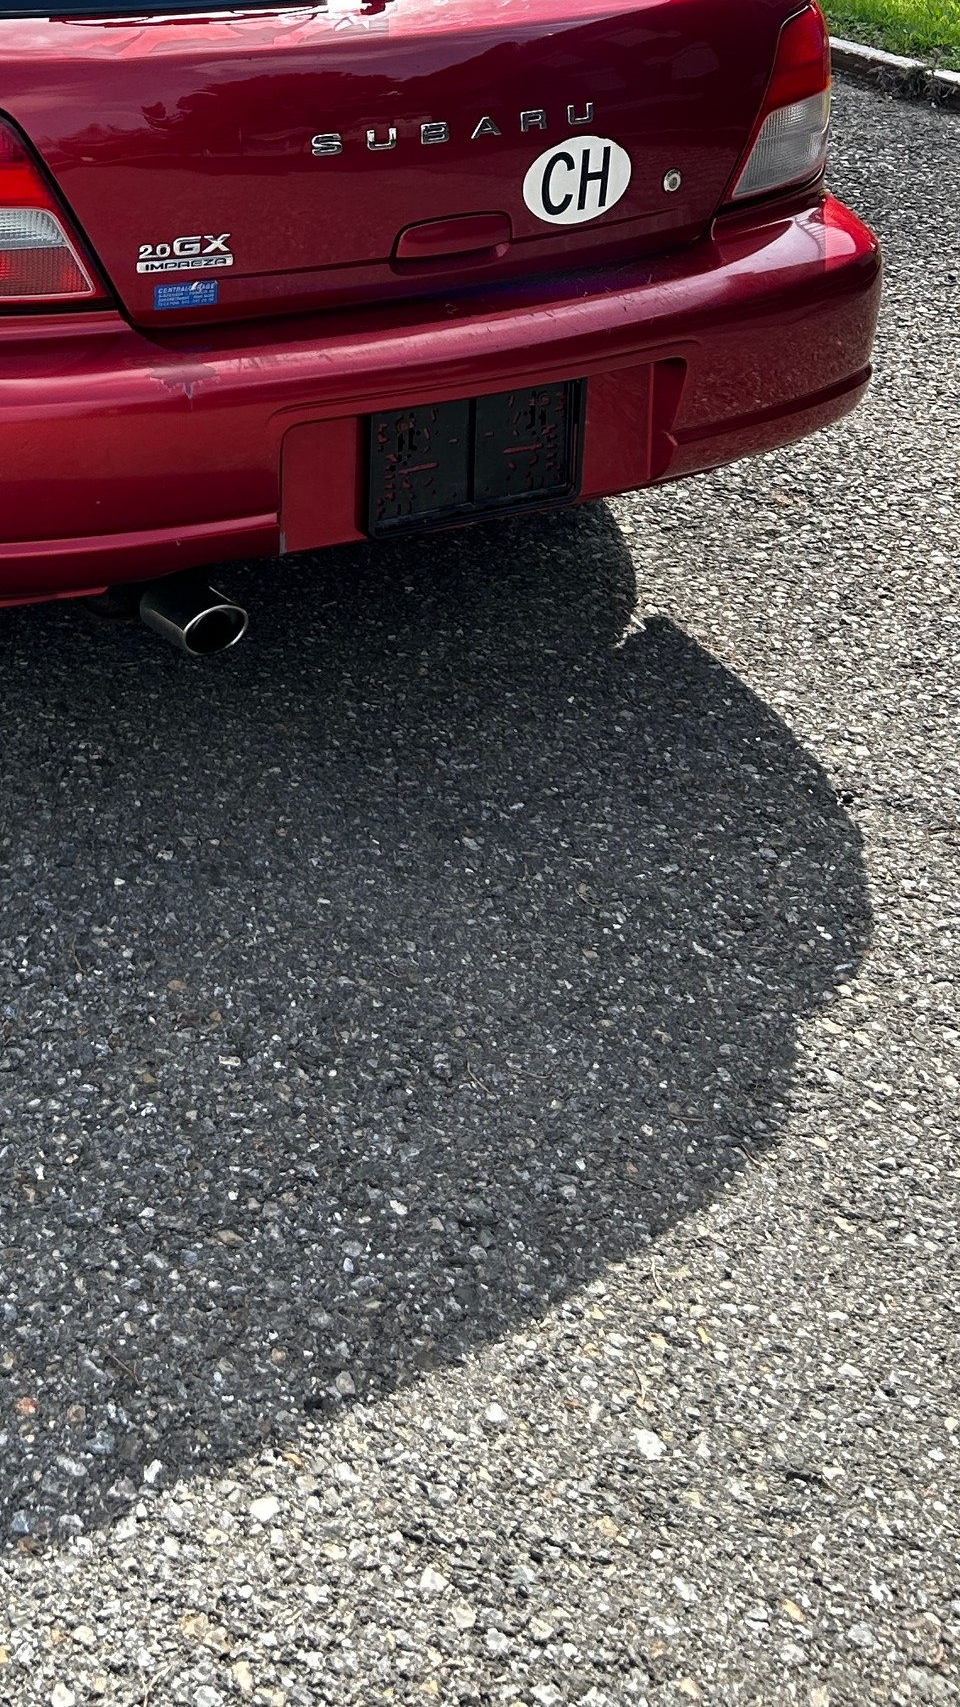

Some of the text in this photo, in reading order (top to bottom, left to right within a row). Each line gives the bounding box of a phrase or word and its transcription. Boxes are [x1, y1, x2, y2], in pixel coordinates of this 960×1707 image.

[311, 102, 594, 156] SUBARU
[541, 146, 612, 216] CH
[145, 257, 227, 271] IMPREZA
